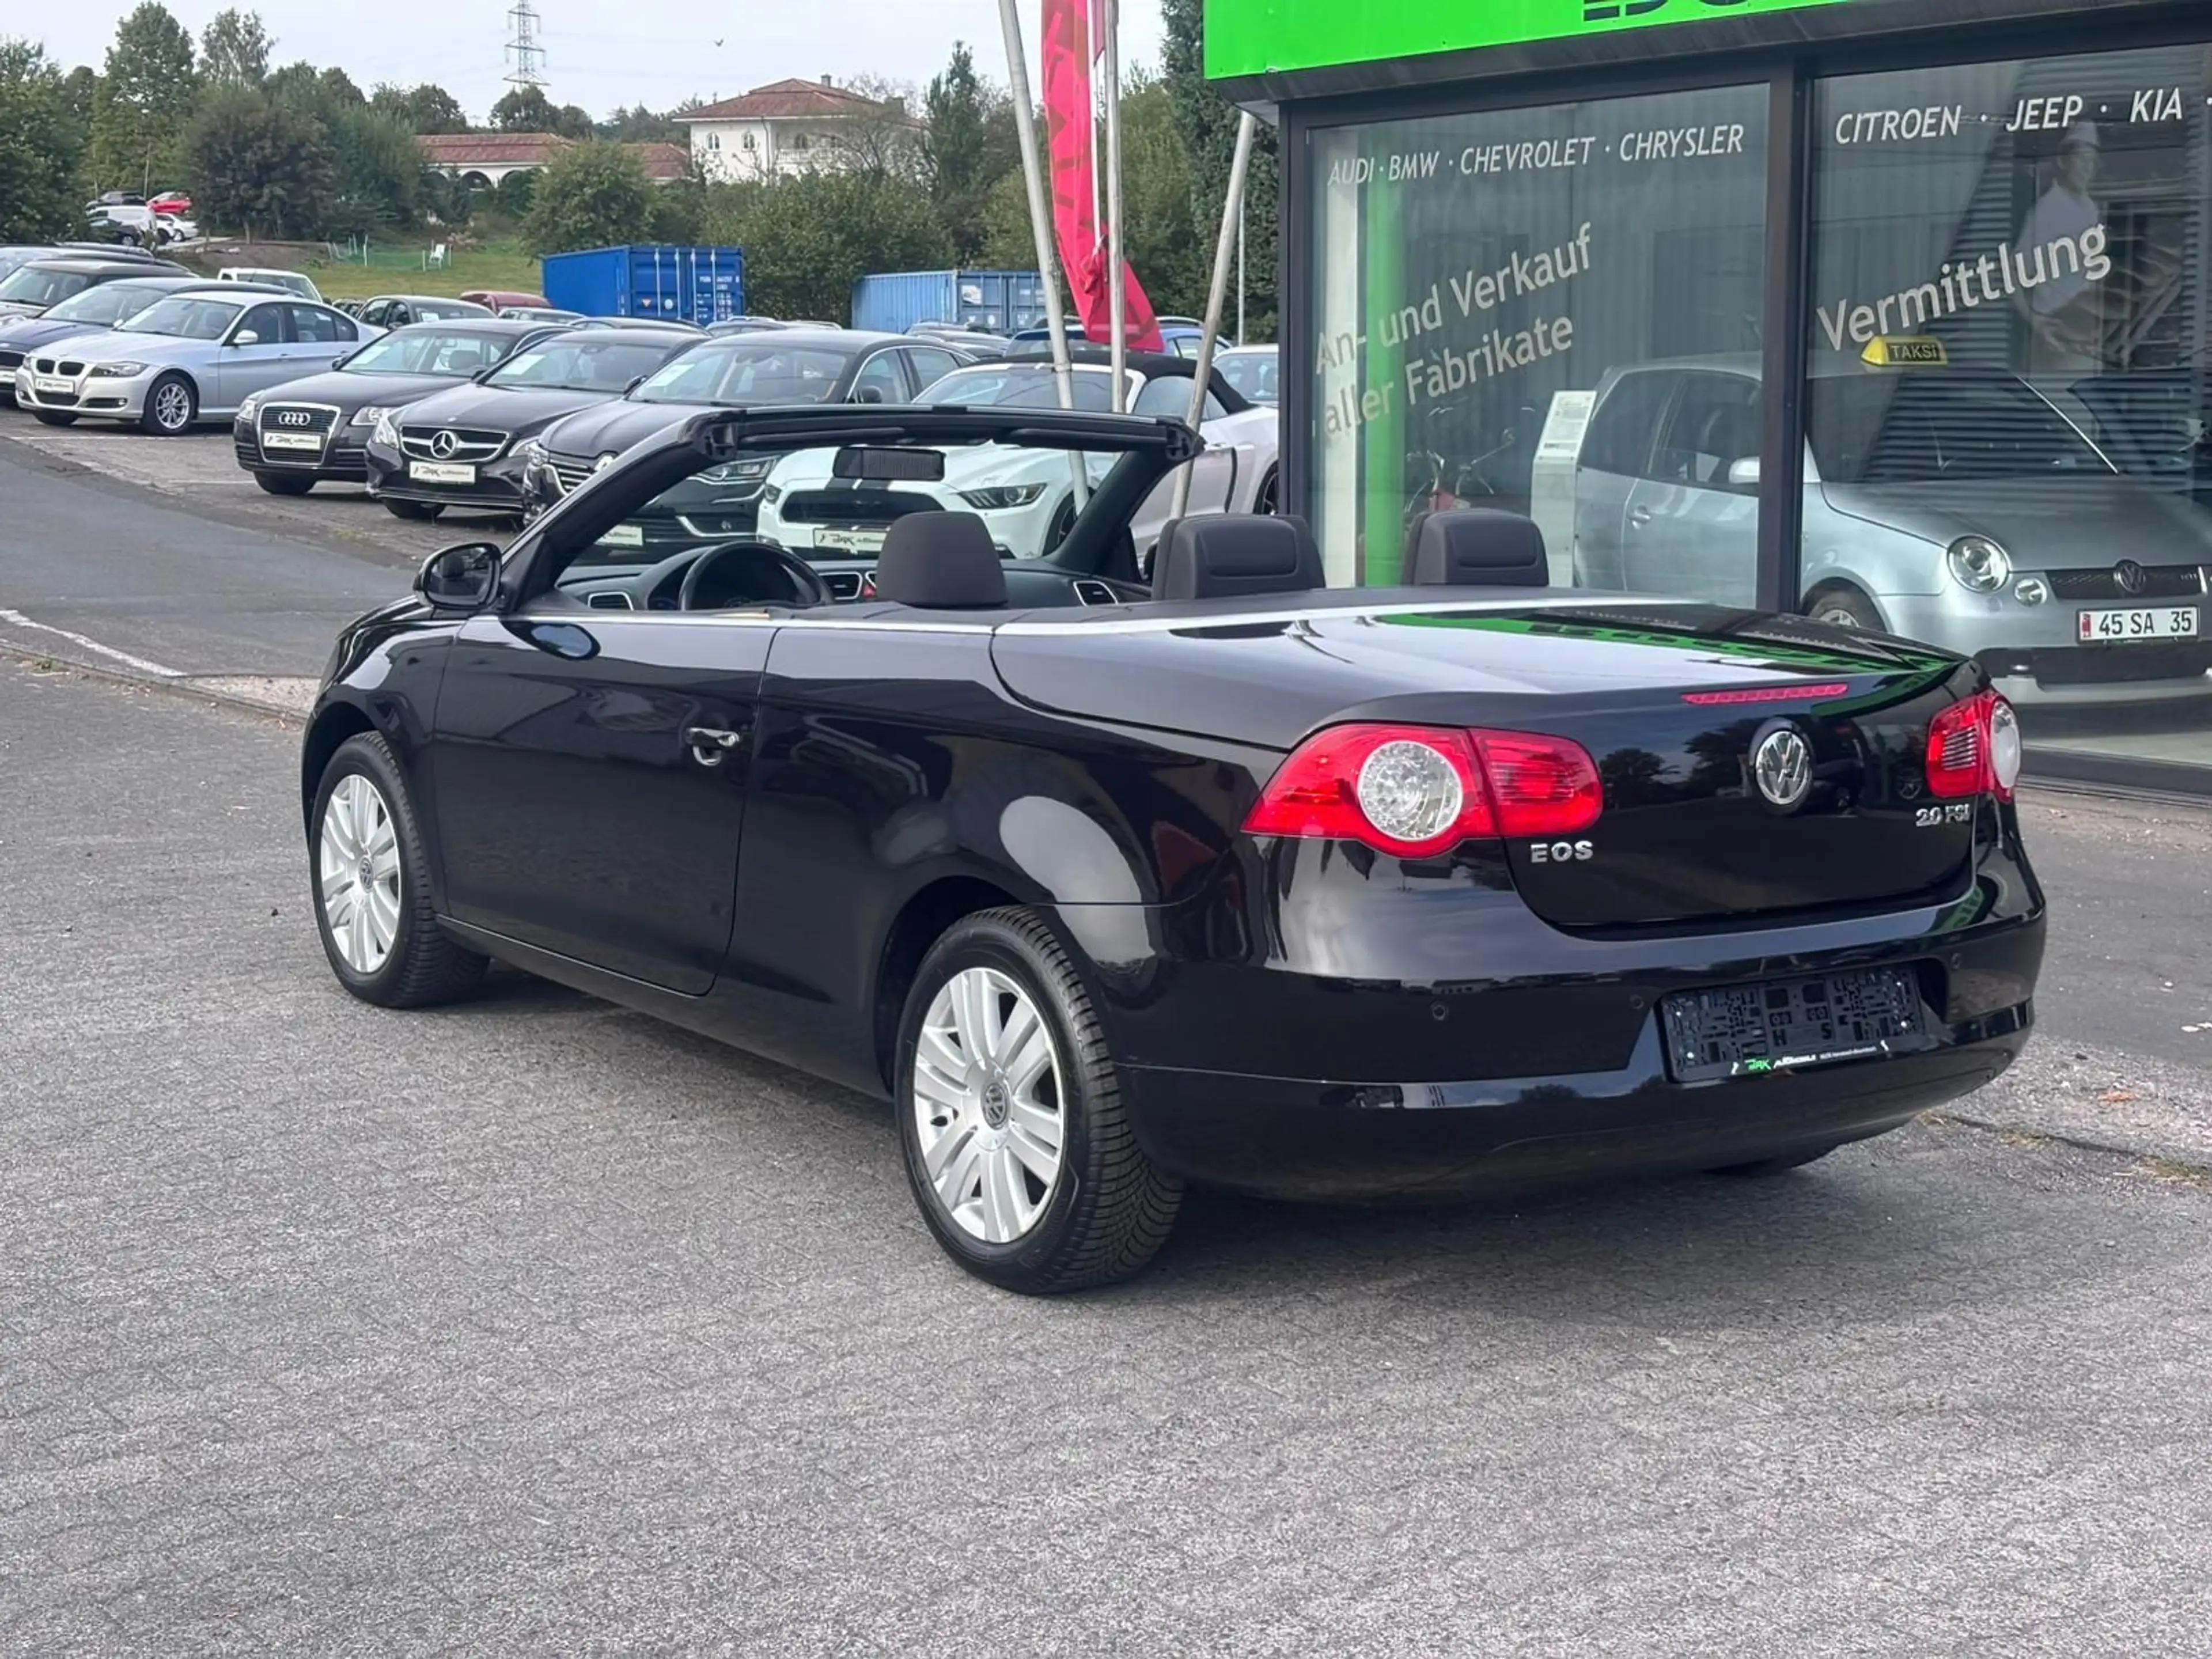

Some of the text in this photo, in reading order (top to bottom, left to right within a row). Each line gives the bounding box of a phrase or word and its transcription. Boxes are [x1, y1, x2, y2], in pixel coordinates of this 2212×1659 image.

[1835, 87, 2183, 145] CITROEN JEEP KIA
[1328, 123, 1744, 186] AUDI BMW CHEVROLET CHRYSLER
[1316, 221, 1591, 375] An- und Verkauf
[1816, 223, 2112, 351] Vermittlung
[1324, 316, 1573, 437] aller Fabrikate
[2099, 613, 2123, 636] 45
[2130, 612, 2155, 634] SA
[2169, 611, 2192, 632] 35
[1530, 840, 1594, 863] EOS
